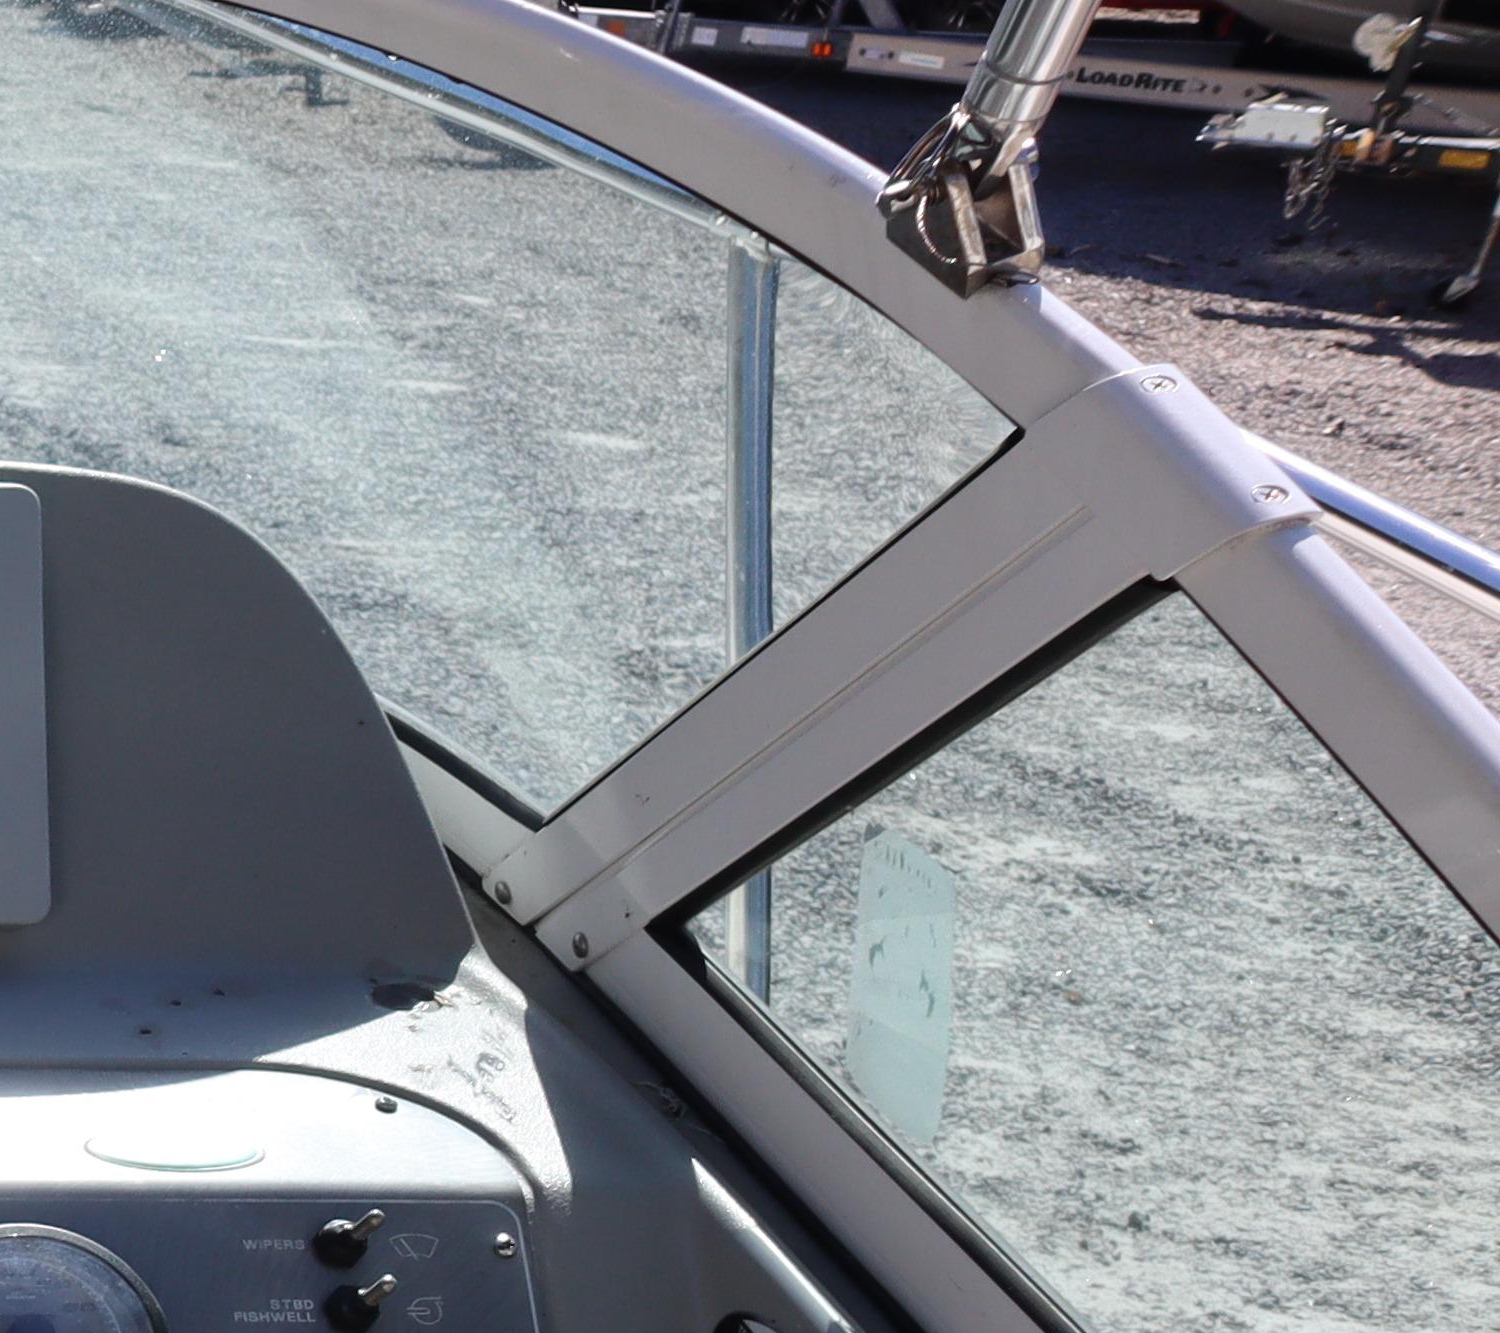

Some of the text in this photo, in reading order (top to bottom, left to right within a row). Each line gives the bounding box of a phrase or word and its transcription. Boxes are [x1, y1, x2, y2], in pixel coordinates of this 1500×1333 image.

[242, 1239, 306, 1250] WIPERS
[269, 1299, 315, 1311] STBD
[234, 1311, 317, 1323] FISHWELL
